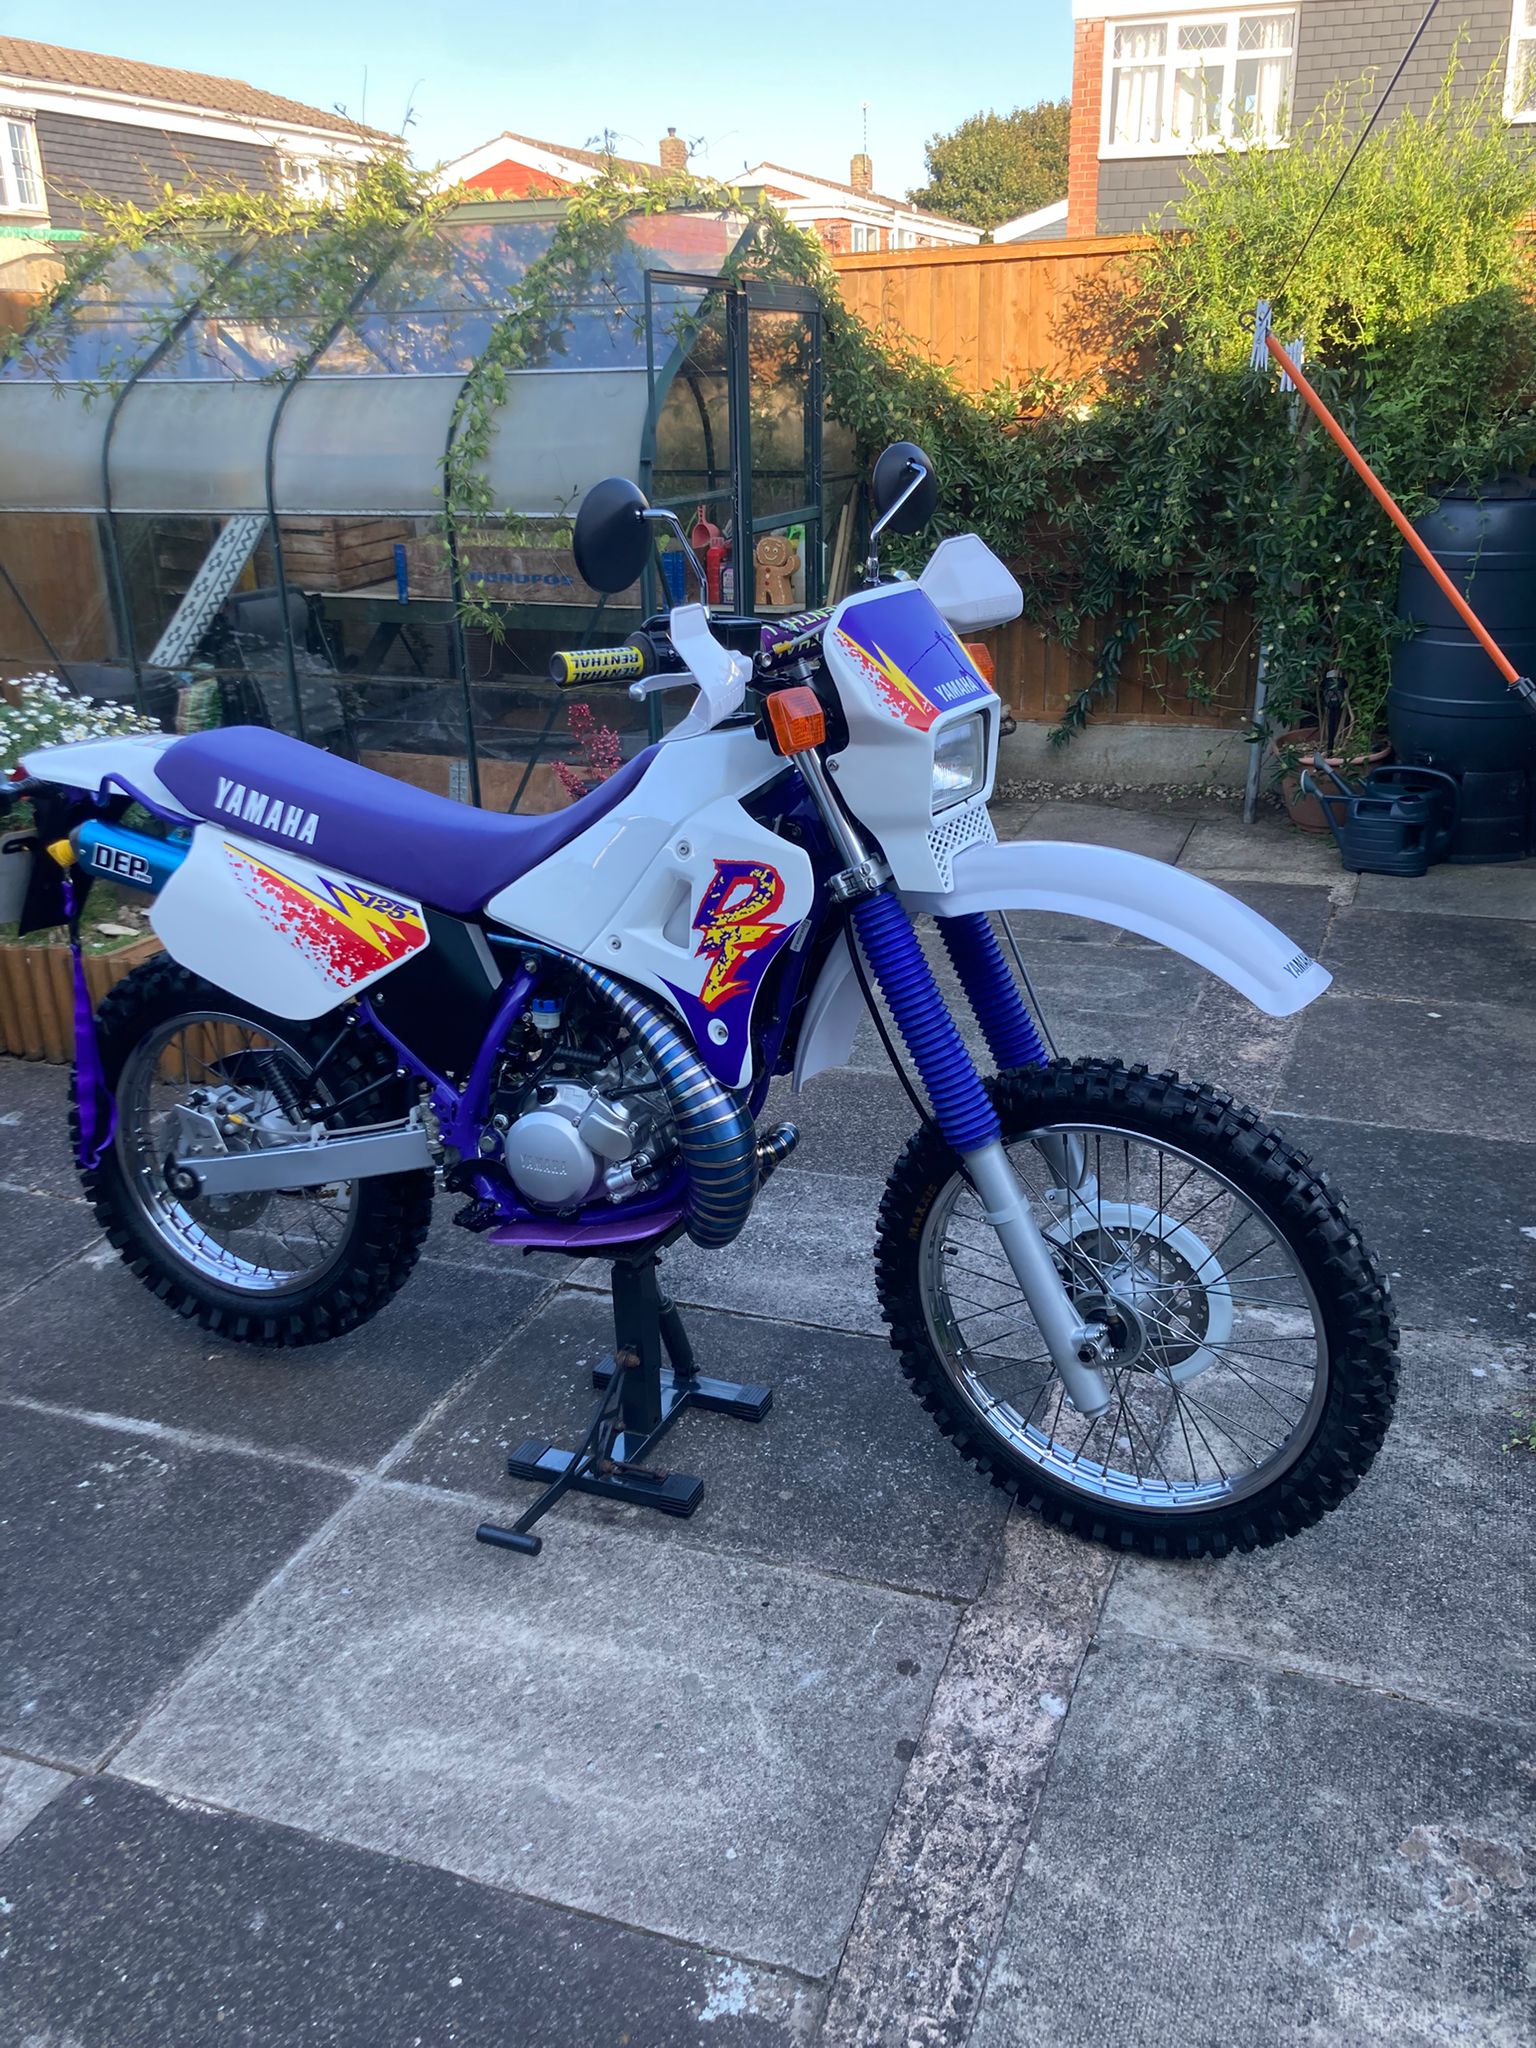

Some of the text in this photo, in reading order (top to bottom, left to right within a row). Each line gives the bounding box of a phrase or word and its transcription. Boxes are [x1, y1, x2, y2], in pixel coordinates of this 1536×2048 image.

[571, 653, 639, 669] RENTHAL
[933, 675, 980, 703] YAMAHA
[214, 776, 320, 846] YAMAHA
[95, 845, 146, 876] DEP
[362, 894, 407, 921] 125
